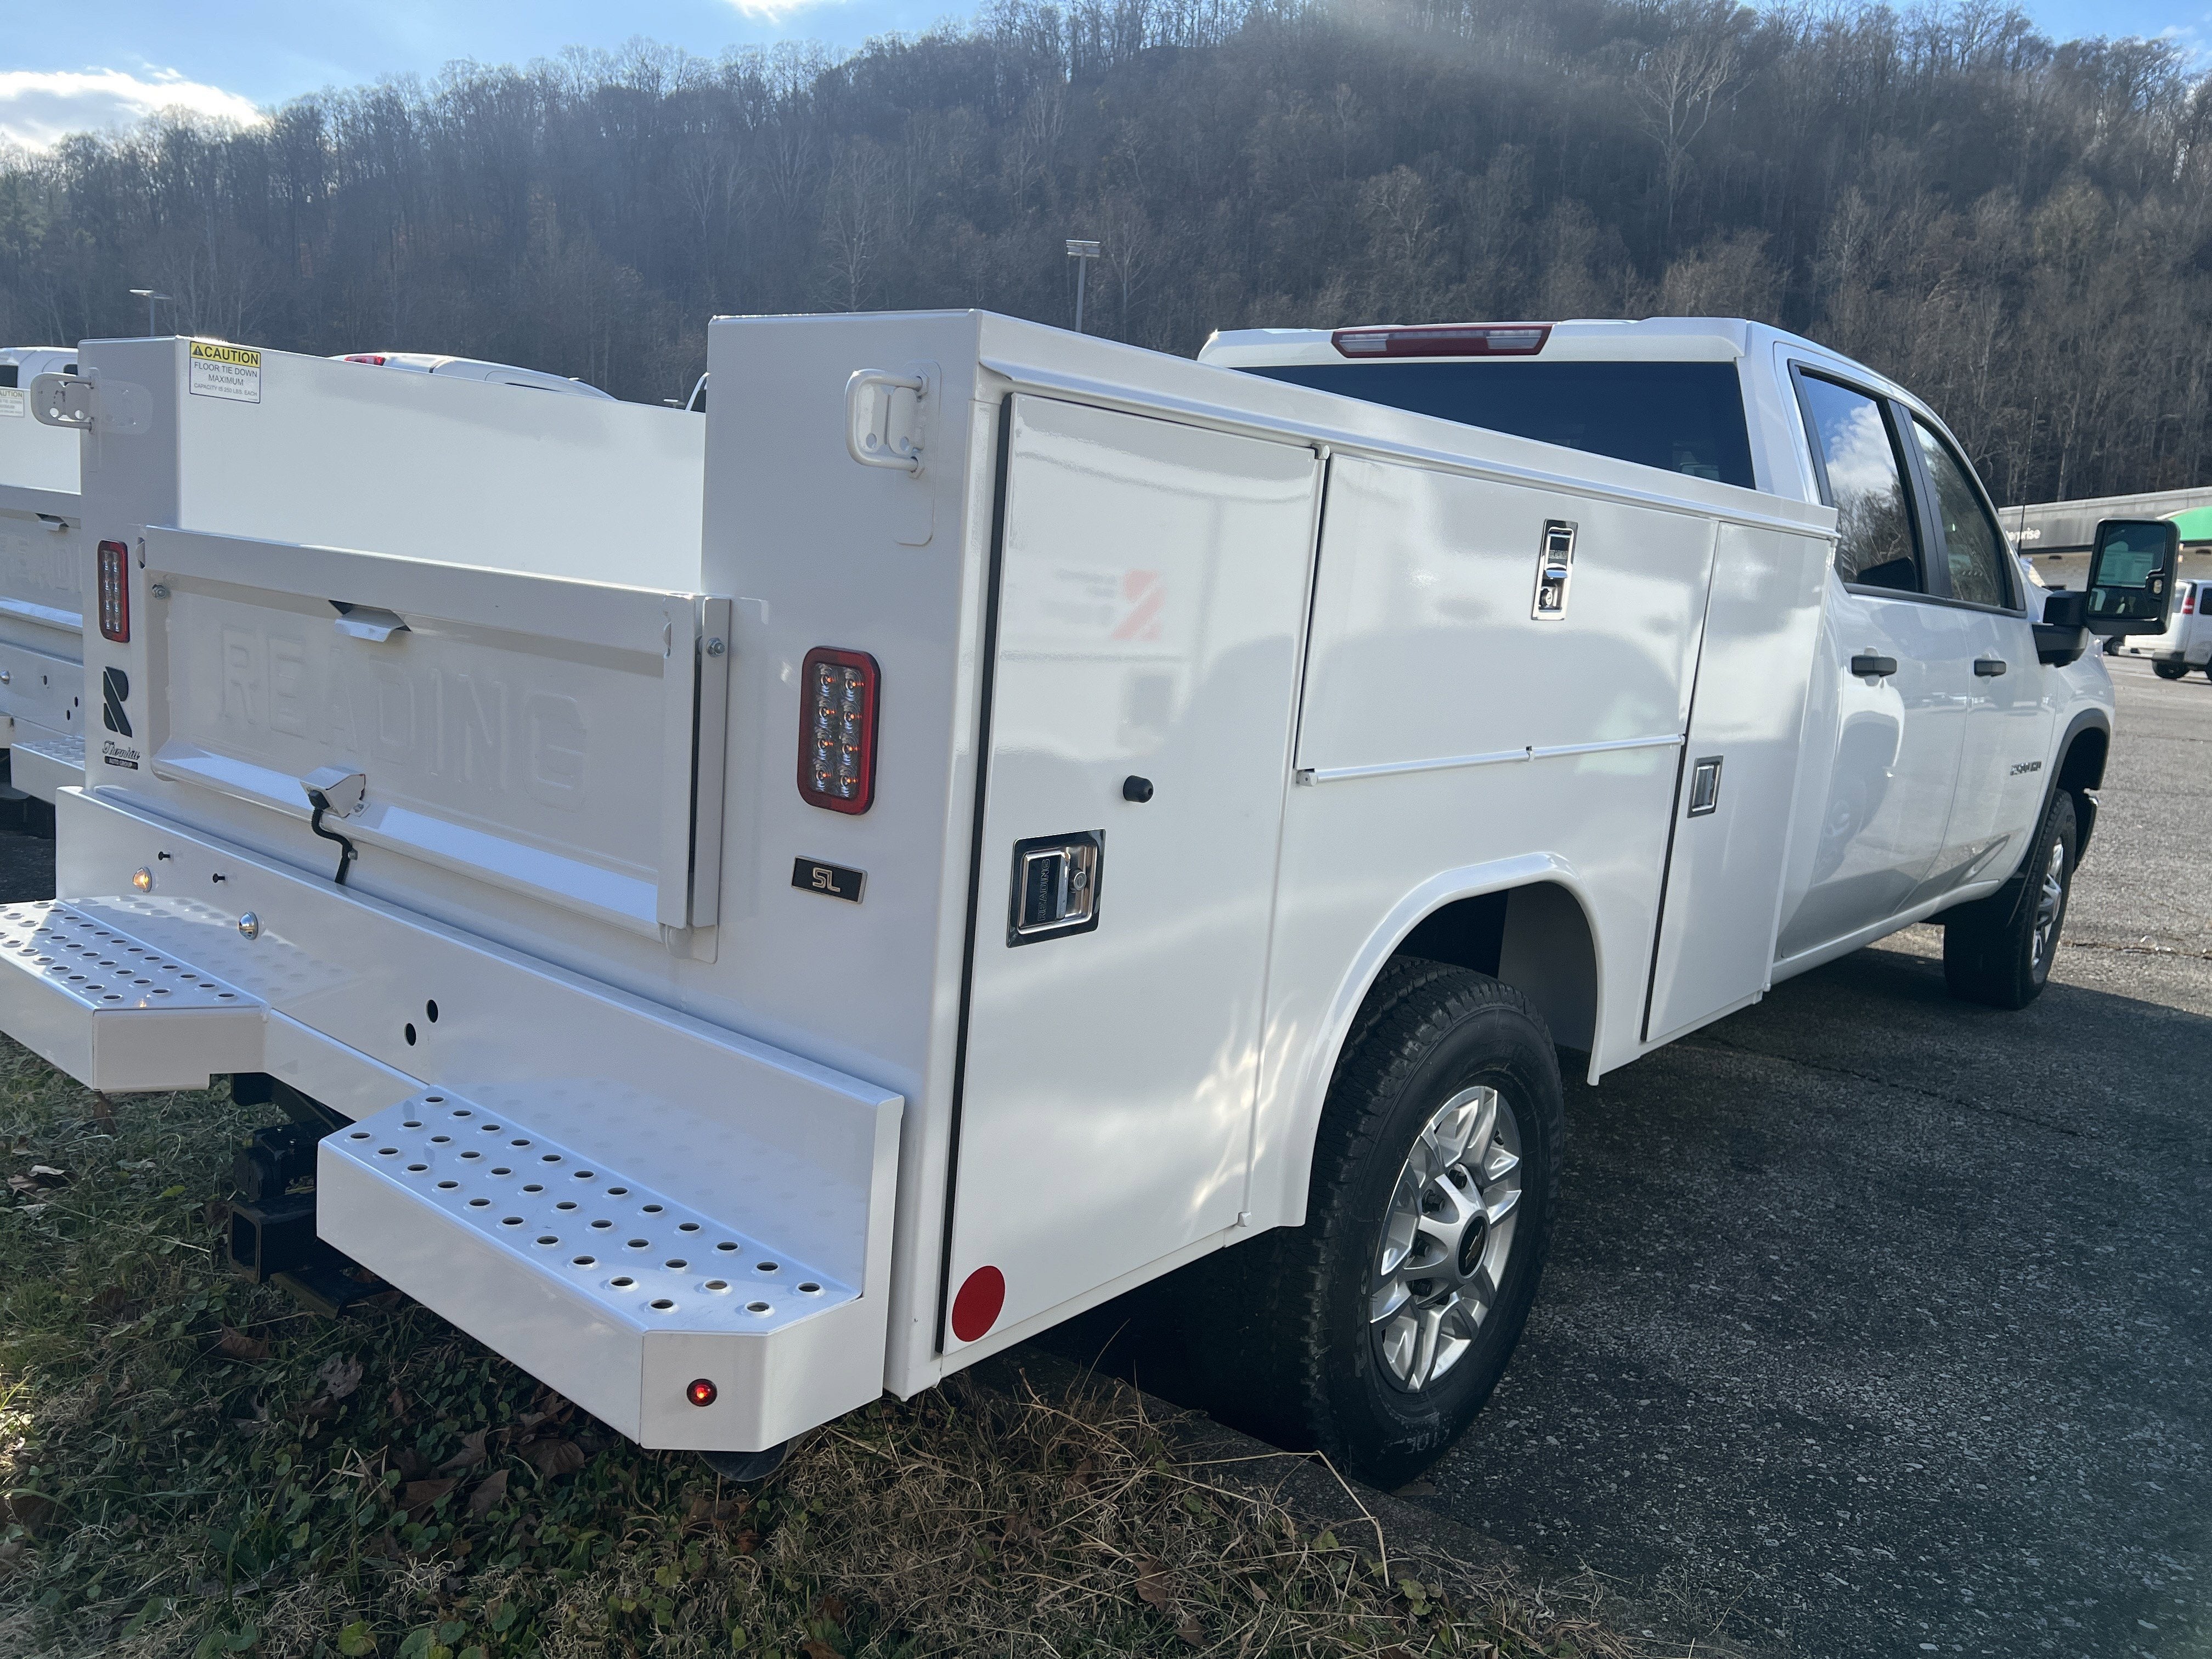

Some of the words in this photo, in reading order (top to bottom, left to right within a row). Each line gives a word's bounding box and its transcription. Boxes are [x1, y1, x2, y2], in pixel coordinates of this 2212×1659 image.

[204, 346, 258, 365] CAUTION
[194, 362, 219, 372] FLOOR
[222, 365, 233, 374] TIE
[235, 368, 257, 377] DOWN
[208, 374, 244, 386] MAXIMUM
[221, 622, 588, 814] READING
[812, 867, 841, 893] SL
[1037, 858, 1051, 922] READING
